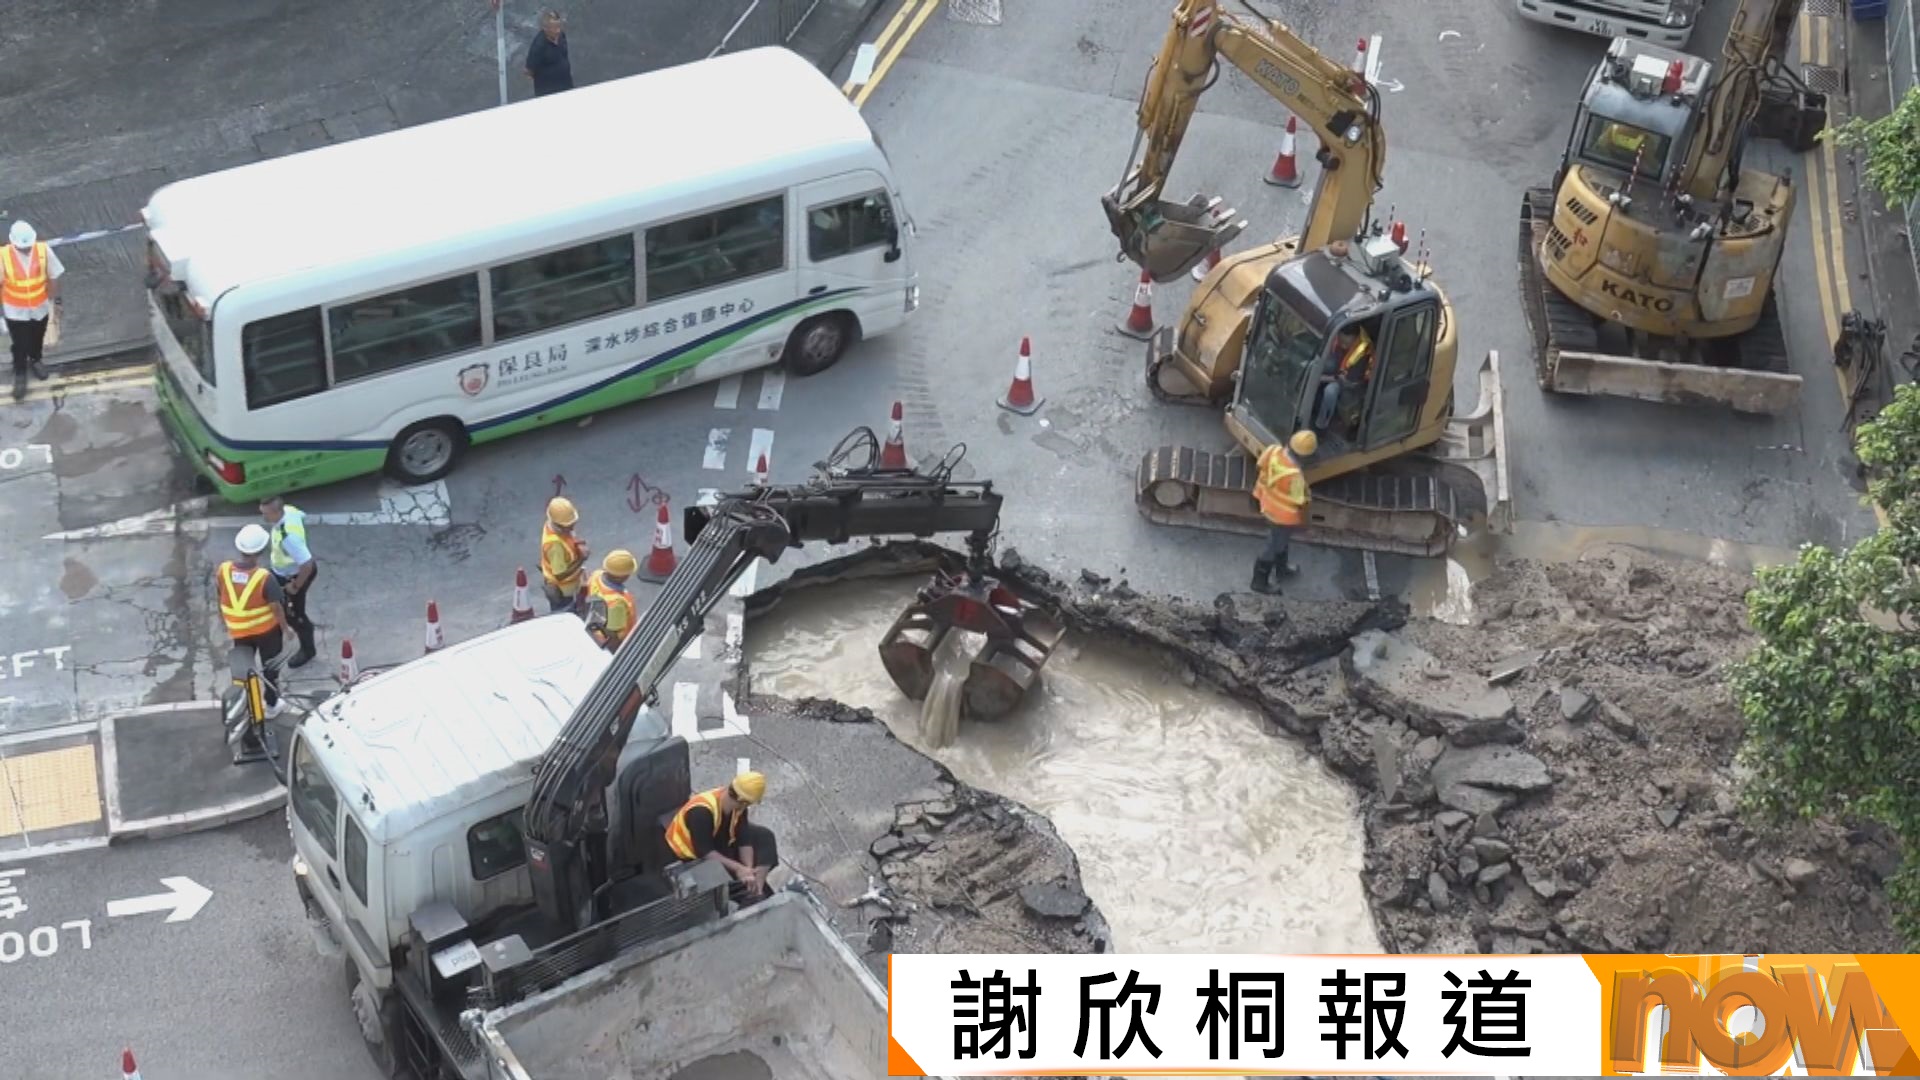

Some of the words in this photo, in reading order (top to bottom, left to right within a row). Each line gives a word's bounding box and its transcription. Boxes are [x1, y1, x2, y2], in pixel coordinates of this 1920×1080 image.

[1254, 57, 1300, 96] KATO
[1602, 279, 1674, 312] KATO
[498, 343, 568, 377] 保良局
[0, 645, 71, 679] FT
